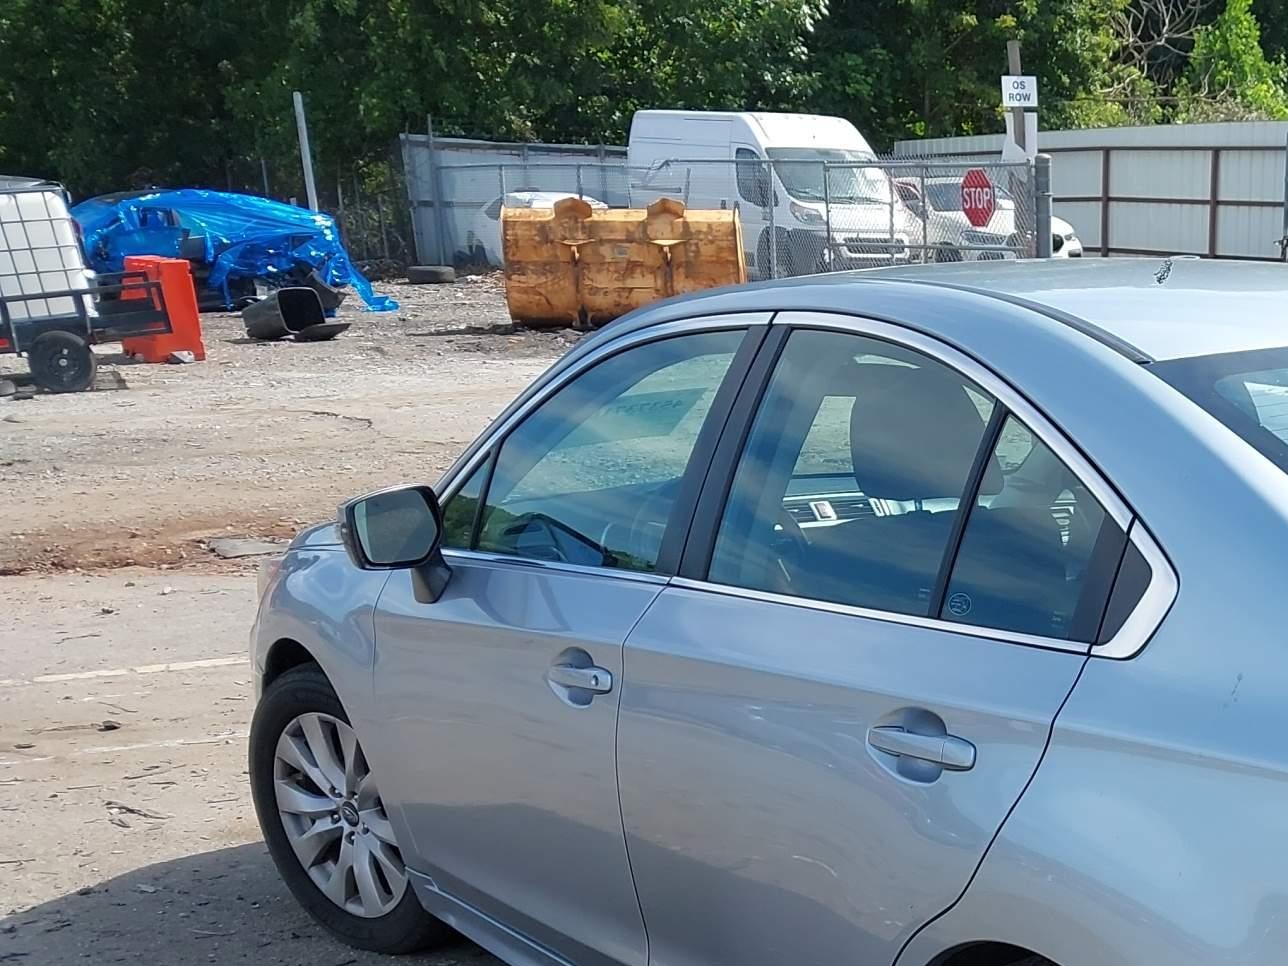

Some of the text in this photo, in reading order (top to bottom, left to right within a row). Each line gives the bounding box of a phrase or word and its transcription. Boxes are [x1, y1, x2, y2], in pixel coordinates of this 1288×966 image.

[1012, 80, 1026, 90] OS
[1008, 92, 1032, 102] ROW
[963, 187, 991, 209] STOP
